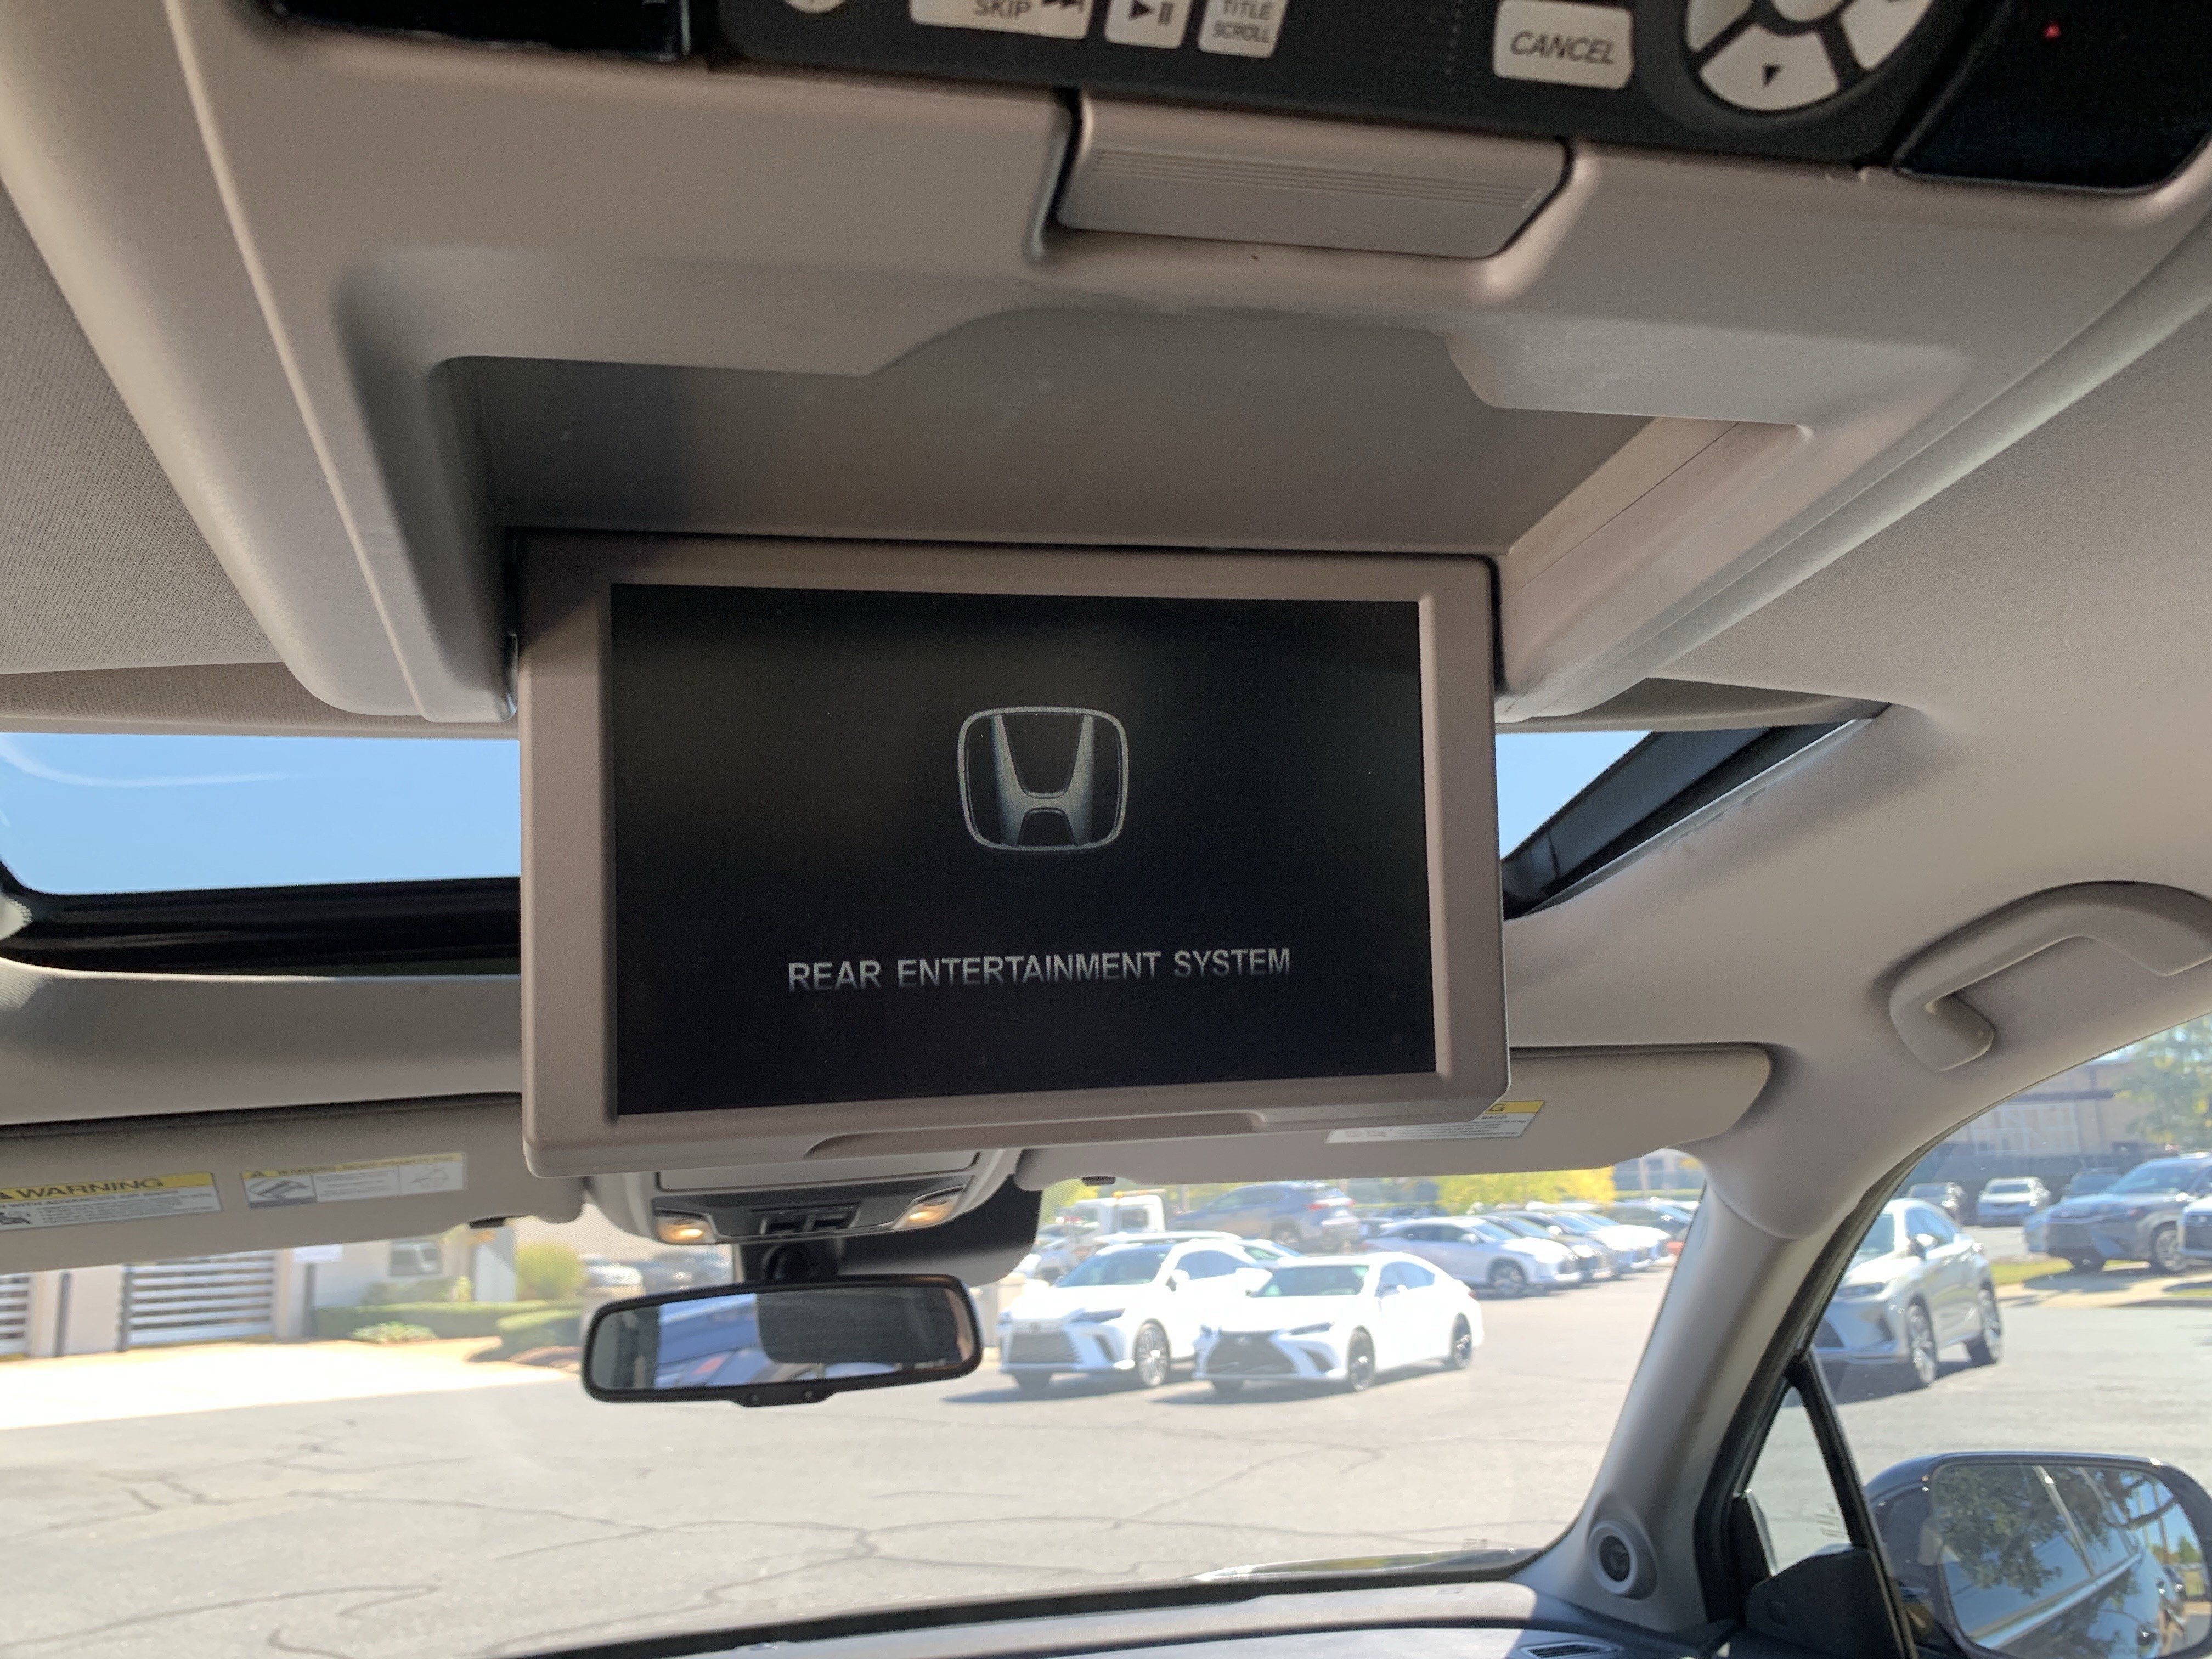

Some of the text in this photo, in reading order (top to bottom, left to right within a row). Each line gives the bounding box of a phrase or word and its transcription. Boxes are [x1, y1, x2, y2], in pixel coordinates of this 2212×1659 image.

[974, 0, 1032, 19] SKIP
[1223, 0, 1273, 20] TITLE
[1212, 20, 1271, 43] SCROLL
[1510, 30, 1615, 66] CANCEL
[788, 947, 1290, 992] REAR ENTERTAINMENT SYSTEM
[15, 1178, 164, 1198] WARNING
